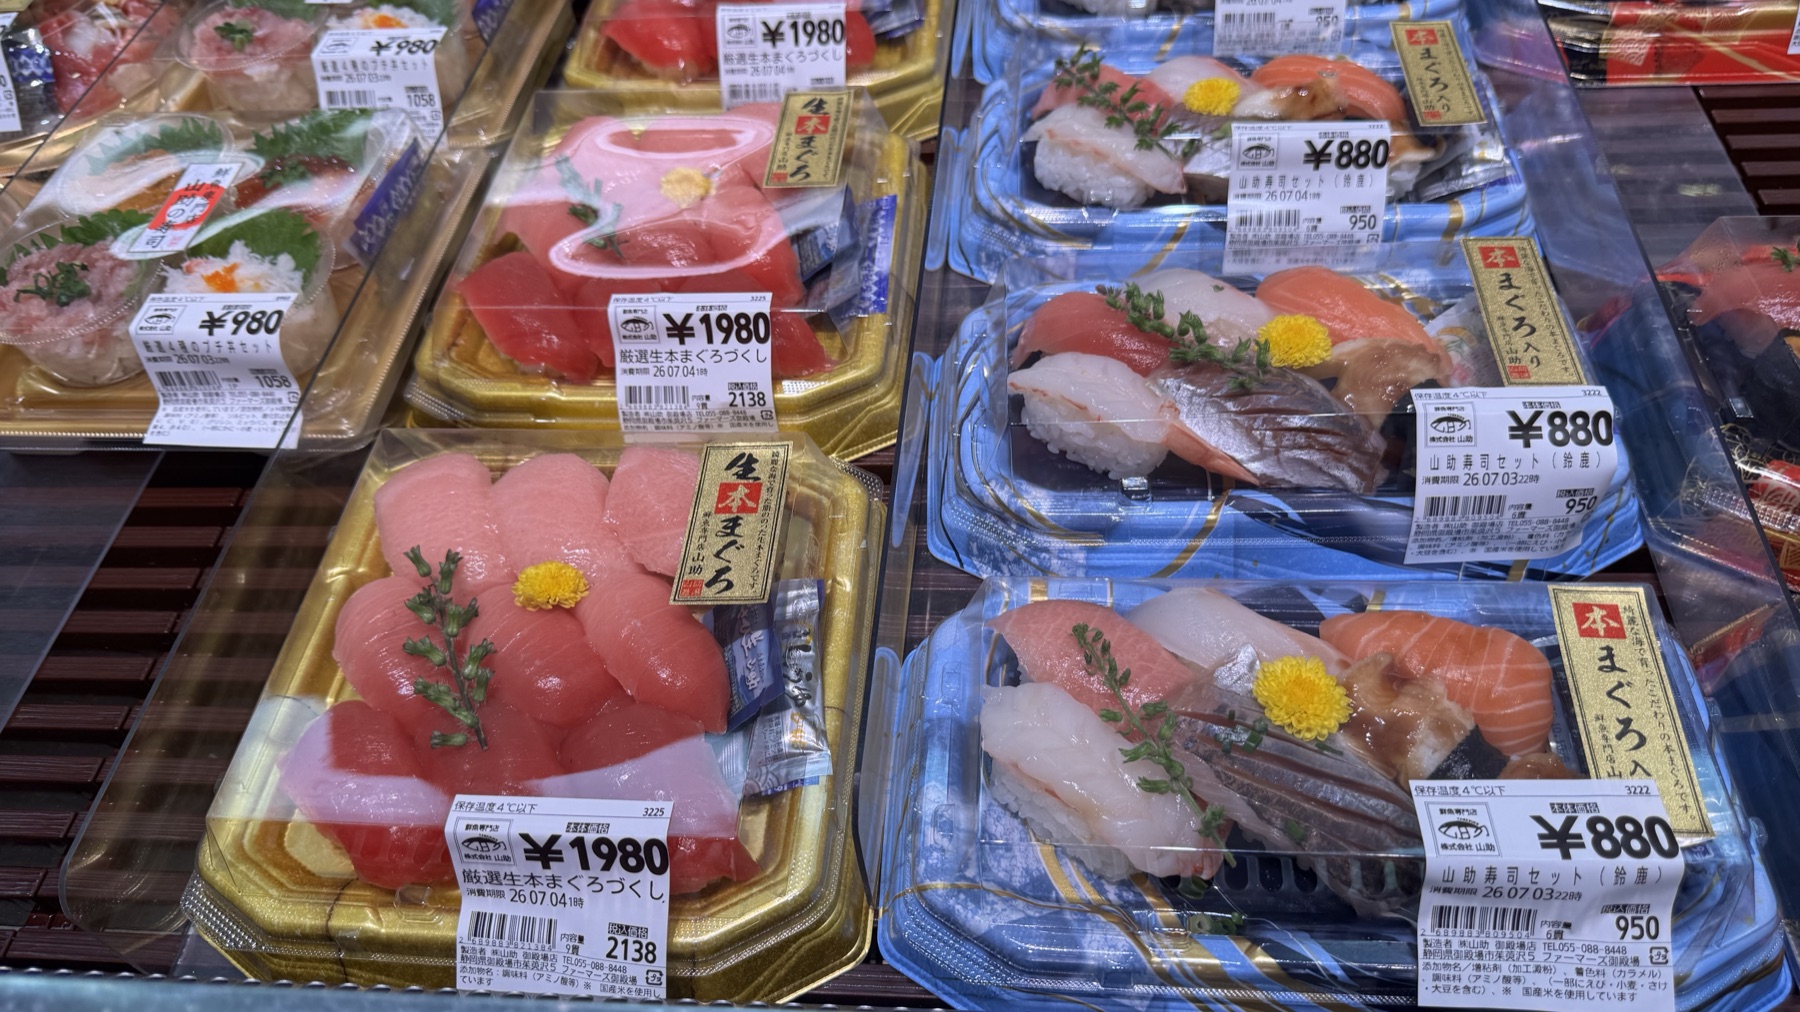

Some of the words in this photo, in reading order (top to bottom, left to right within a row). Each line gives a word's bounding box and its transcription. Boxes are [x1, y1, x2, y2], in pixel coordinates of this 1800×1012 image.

[761, 19, 845, 48] ¥1980
[370, 40, 438, 56] ¥980
[407, 94, 436, 107] 1058
[1303, 140, 1389, 171] ¥880
[1350, 215, 1376, 230] 950
[1485, 248, 1540, 368] 本まぐろ入り
[198, 310, 284, 336] ¥980
[663, 312, 770, 345] ¥1980
[620, 349, 767, 363] 厳選生本まぐろづくし
[255, 375, 292, 388] 1058
[729, 392, 766, 407] 2138
[1506, 410, 1614, 448] ¥880
[1565, 496, 1598, 514] 950
[705, 452, 762, 596] 生本まぐろ
[1580, 606, 1651, 777] 本まぐろ入
[1594, 713, 1622, 778] 鮮魚専門店山
[1414, 785, 1506, 796] 保存温度4℃以下
[1624, 785, 1651, 795] 3222
[454, 801, 538, 814] 保存温度4℃以下
[642, 807, 665, 817] 3225
[1529, 815, 1680, 860] ¥880
[518, 833, 669, 876] ¥1980
[1441, 843, 1473, 851] 株式会社
[1476, 843, 1496, 852] 山助
[494, 854, 512, 862] 山助
[462, 868, 664, 900] 厳選生本まぐろづくし
[466, 887, 506, 899] 消費期限
[510, 888, 567, 907] 26.07.04
[569, 896, 584, 909] 1時
[1430, 886, 1478, 896] 消費期限
[1482, 886, 1554, 901] 26.07.03
[1540, 920, 1572, 929] 内容量
[1616, 915, 1660, 940] 950
[560, 933, 584, 945] 内容量
[1435, 929, 1480, 937] 689883
[1486, 929, 1530, 939] 809504
[606, 936, 657, 964] 2138
[1422, 938, 1452, 950] 製造者
[1495, 939, 1537, 951] 御殿場店
[1543, 942, 1627, 955] TEL055-088-8448
[460, 946, 486, 956] 製造者
[563, 956, 627, 974] TEL055-088-8448
[1542, 951, 1640, 967] ファーマーズ御殿場
[460, 975, 494, 986] ています
[562, 964, 637, 985] ファーマーズ御殿場
[1522, 987, 1638, 1002] 国産米を使用しています
